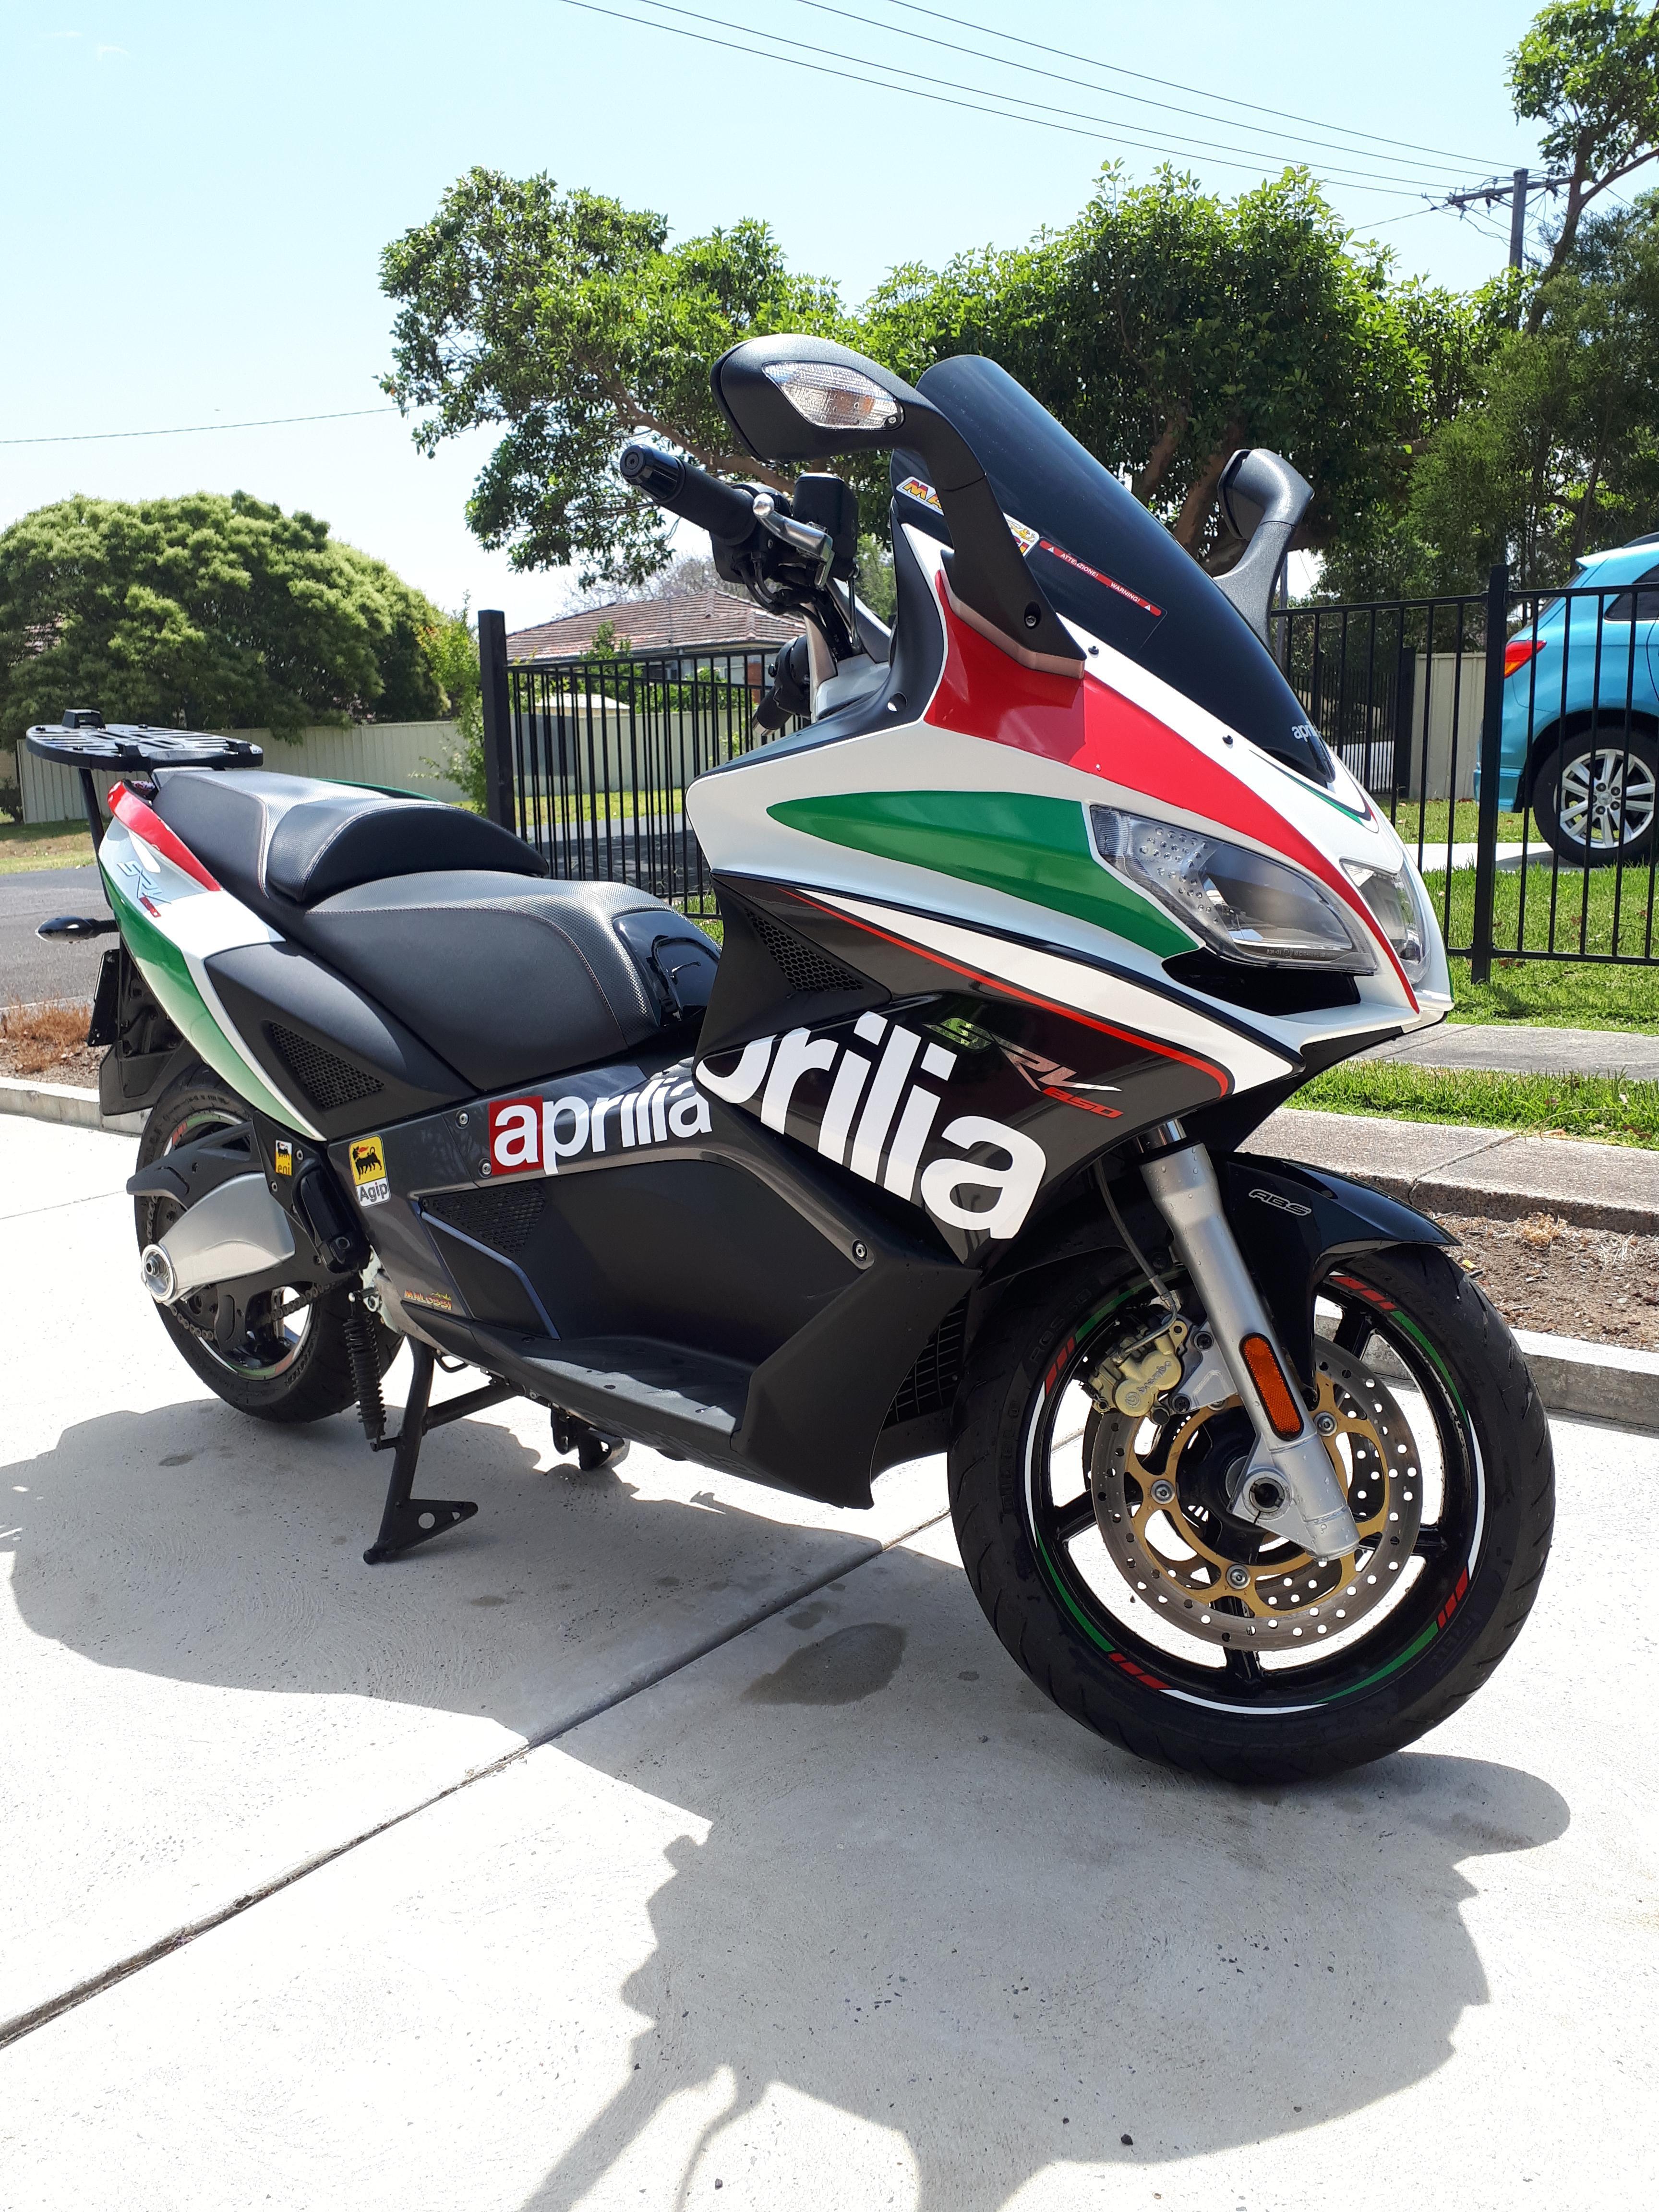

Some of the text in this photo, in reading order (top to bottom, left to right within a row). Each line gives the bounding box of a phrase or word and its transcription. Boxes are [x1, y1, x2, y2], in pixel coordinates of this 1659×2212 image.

[1060, 553, 1141, 603] ATTENZIONE! WARNING!
[1042, 1086, 1124, 1118] 850
[494, 1077, 712, 1175] aprilia
[277, 1164, 290, 1175] eni
[360, 1182, 388, 1202] Agip
[1248, 1188, 1312, 1216] ABS
[1137, 1360, 1172, 1393] brembo
